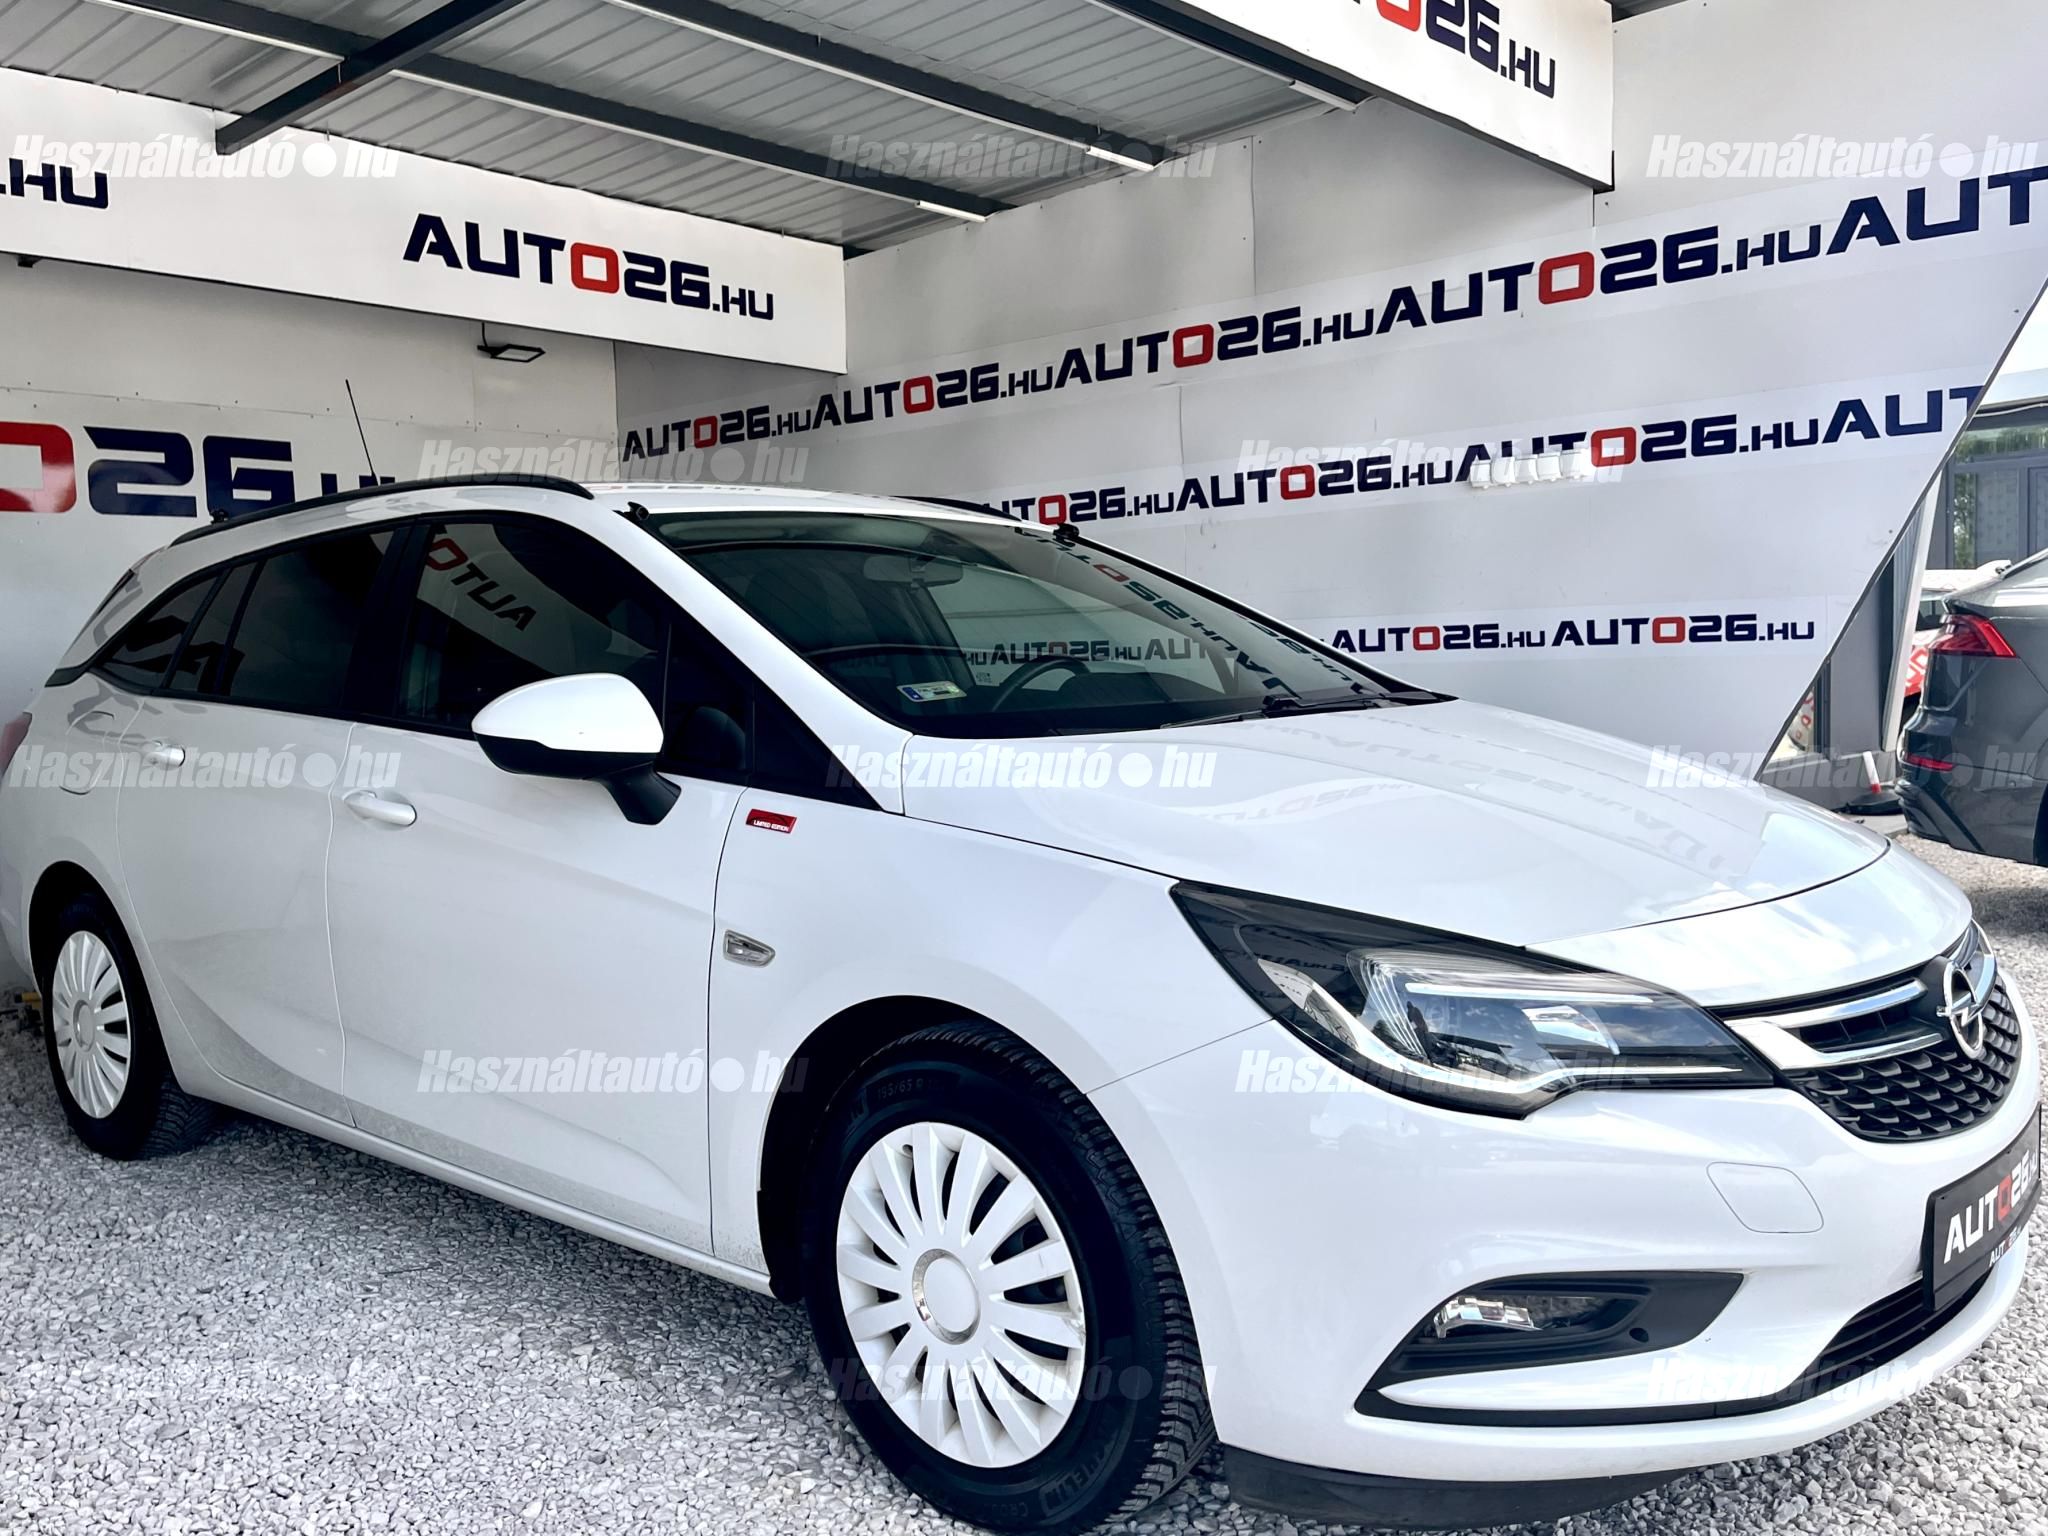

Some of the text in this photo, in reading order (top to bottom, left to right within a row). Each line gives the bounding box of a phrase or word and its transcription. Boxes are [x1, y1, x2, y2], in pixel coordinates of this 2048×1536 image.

[403, 212, 774, 321] AUTO26.HU
[622, 405, 811, 462] AUTO26.HU
[812, 362, 1053, 429] AUTO26.HU
[1055, 306, 1374, 389] AUTO26.HU
[1376, 225, 1821, 335] AUTO26.HU
[0, 421, 395, 517] O26
[1176, 456, 1452, 511] AUTO26.HU
[1332, 614, 1815, 653] AUTO26.HU AUTO26.HU
